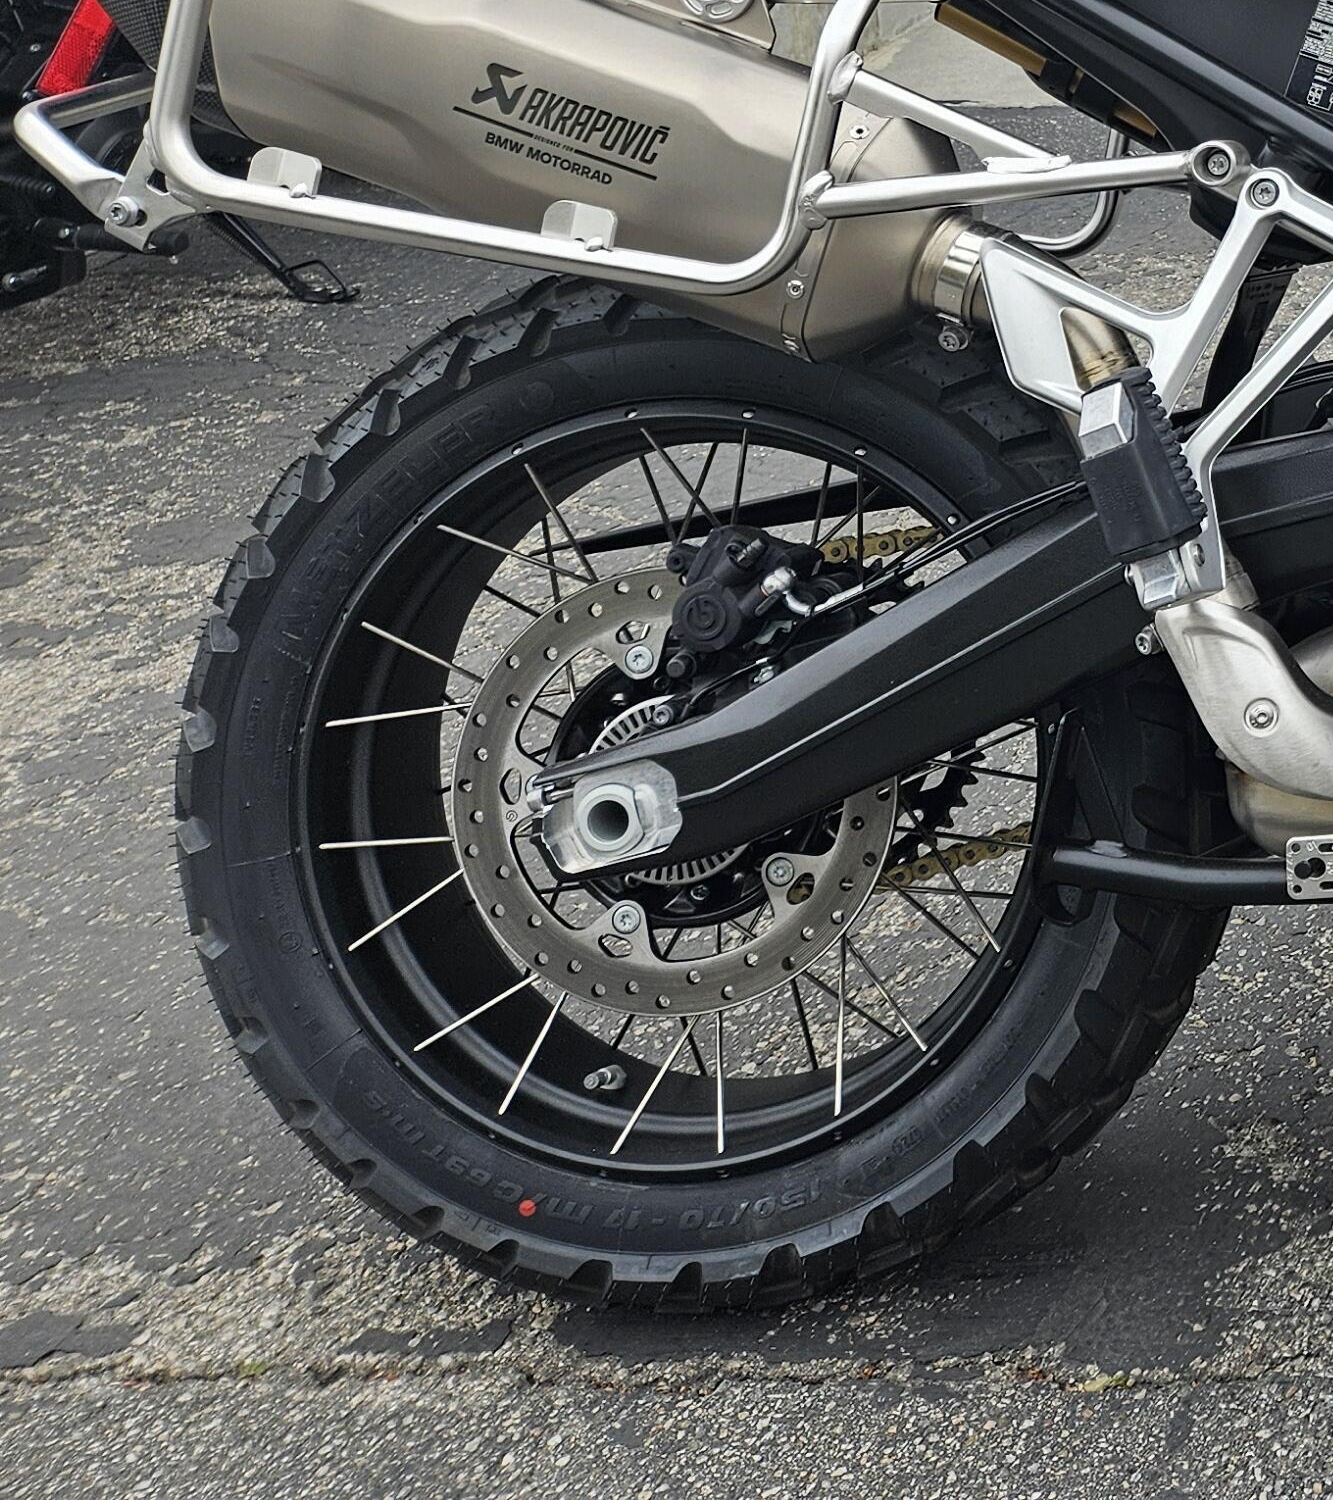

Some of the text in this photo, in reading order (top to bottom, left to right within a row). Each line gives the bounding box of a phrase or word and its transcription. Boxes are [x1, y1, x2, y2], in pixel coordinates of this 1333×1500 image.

[518, 87, 672, 165] AKRAPOVIČ
[484, 132, 613, 185] BMW MOTORRAD
[420, 1138, 492, 1190] 69T
[600, 1204, 642, 1231] 17
[678, 1178, 826, 1231] 150/70
